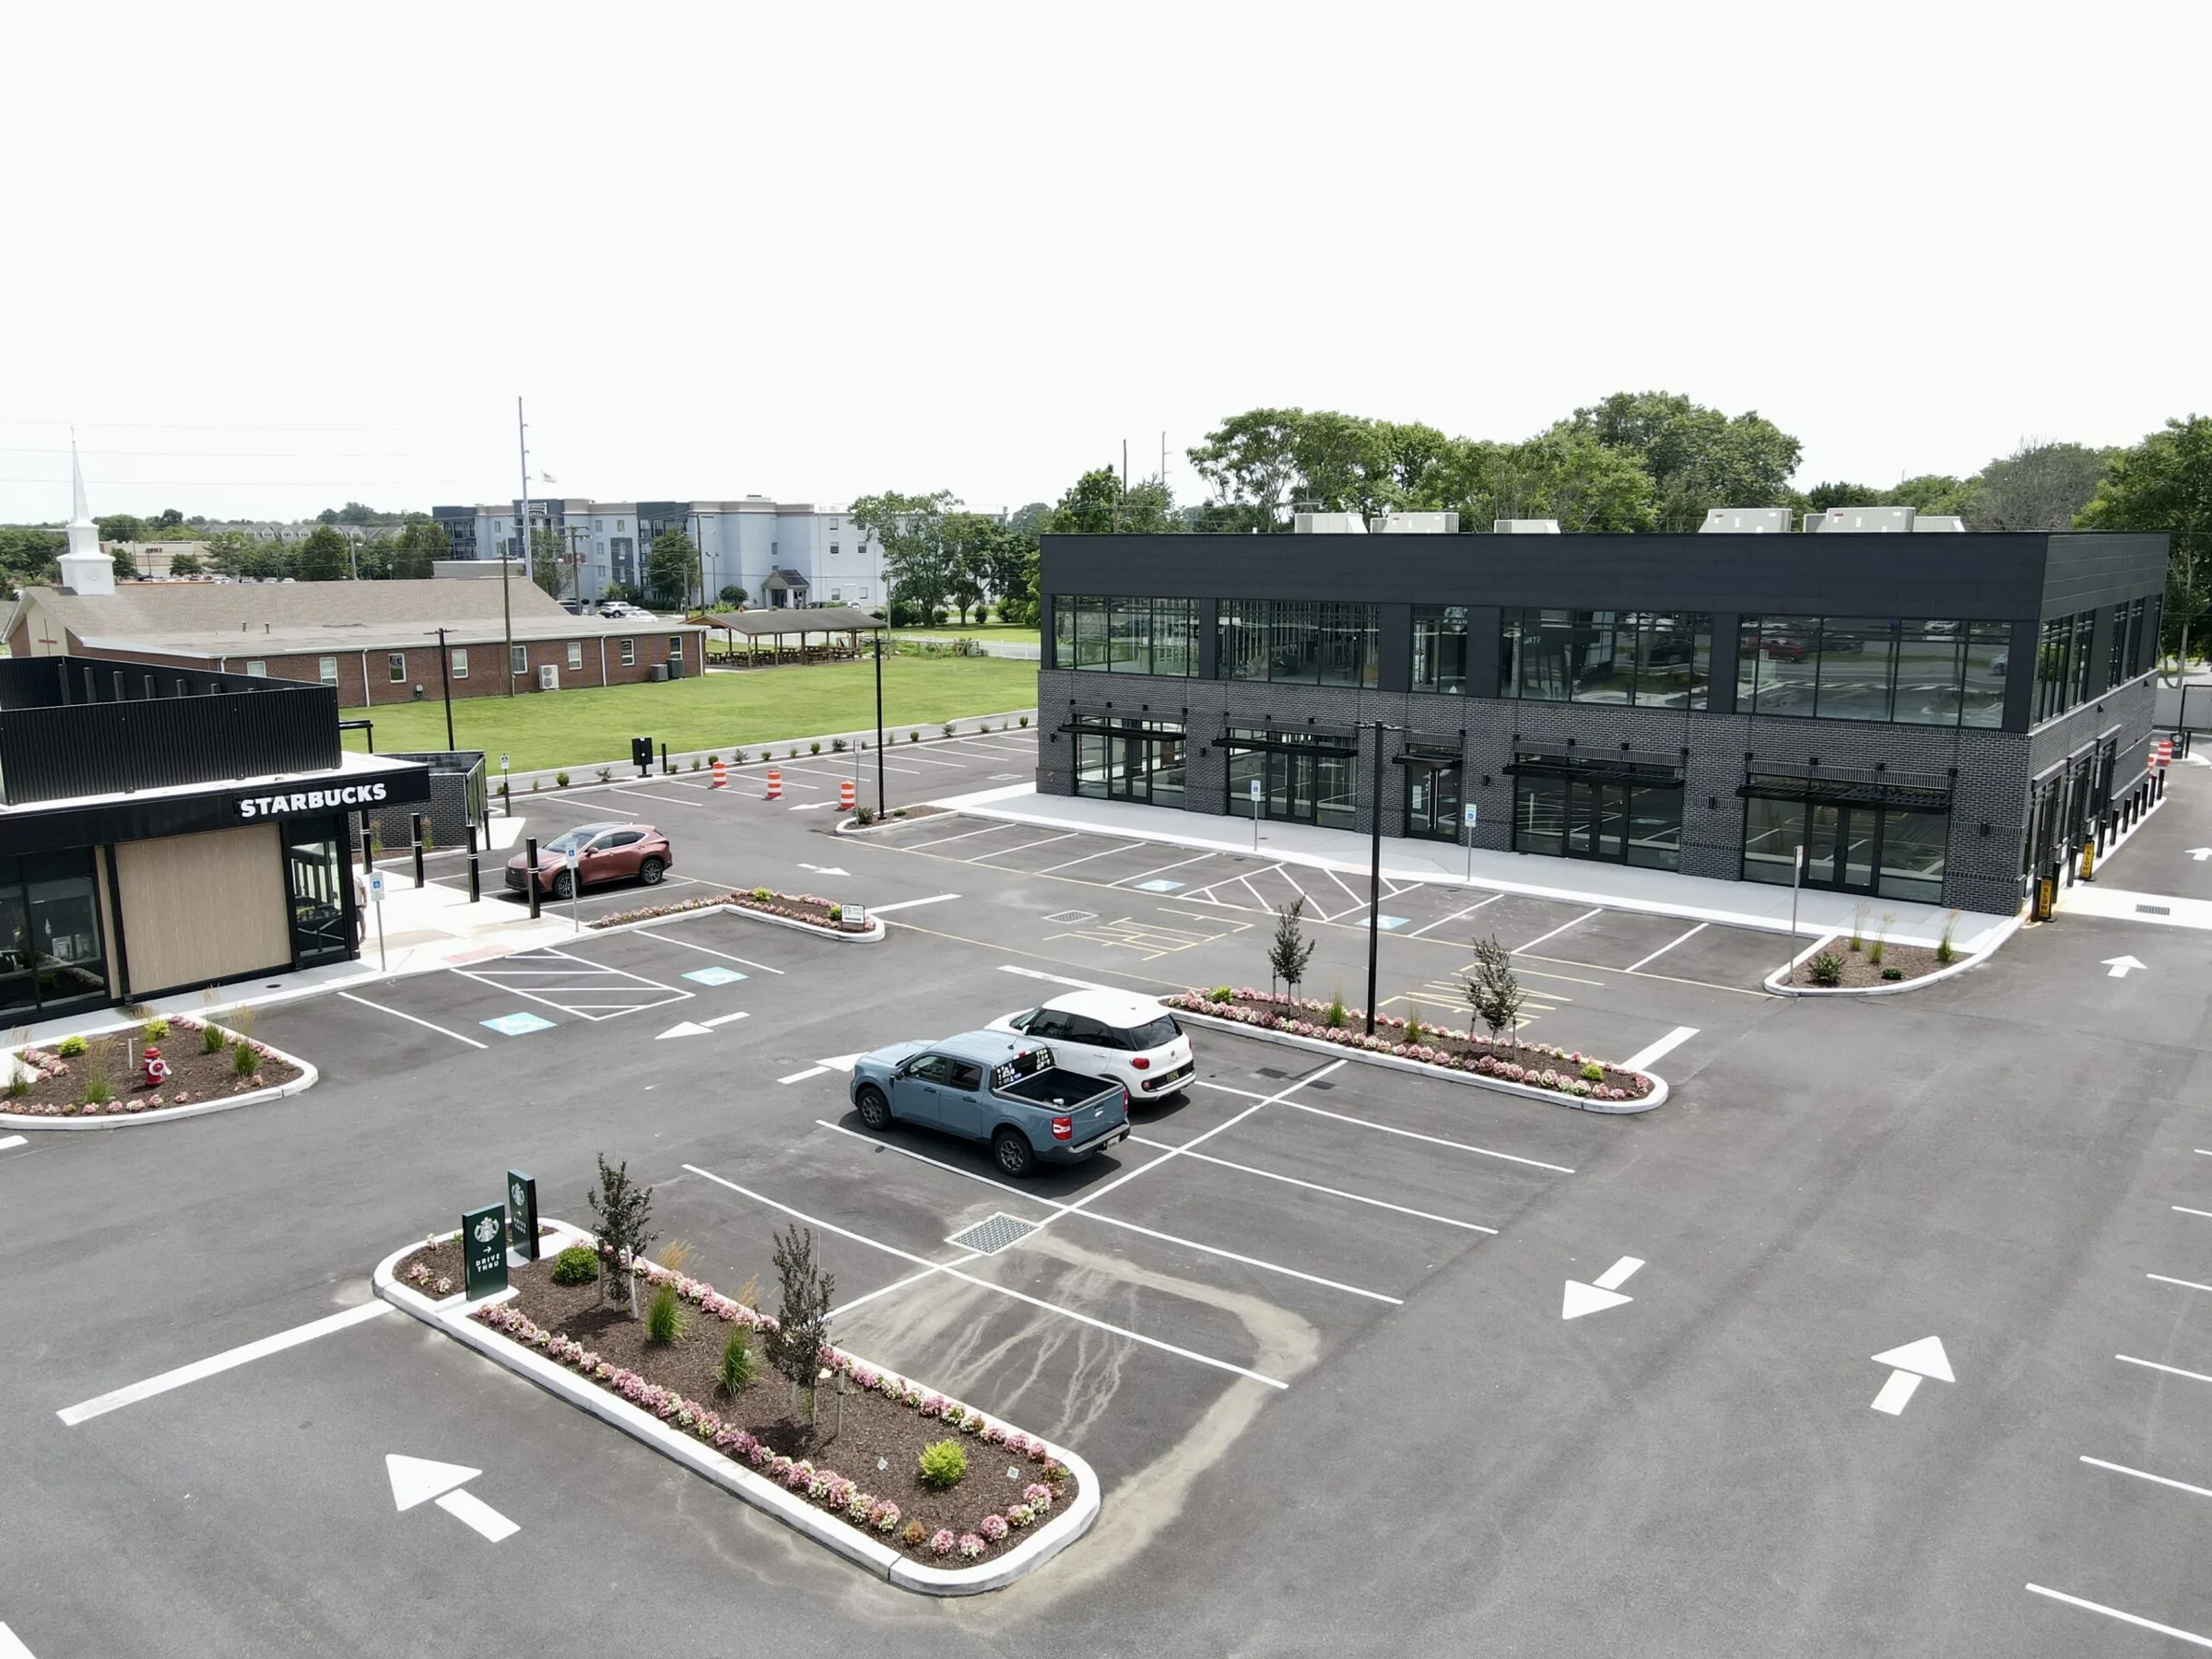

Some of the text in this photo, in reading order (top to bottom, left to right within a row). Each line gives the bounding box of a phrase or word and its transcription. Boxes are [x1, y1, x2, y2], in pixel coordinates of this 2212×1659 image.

[241, 783, 386, 818] STARBUCKS
[2082, 850, 2091, 870] SLOW
[2041, 887, 2049, 911] SLOW
[513, 1216, 526, 1229] DRIVE
[476, 1253, 500, 1266] DRIVE
[477, 1260, 499, 1273] THRU
